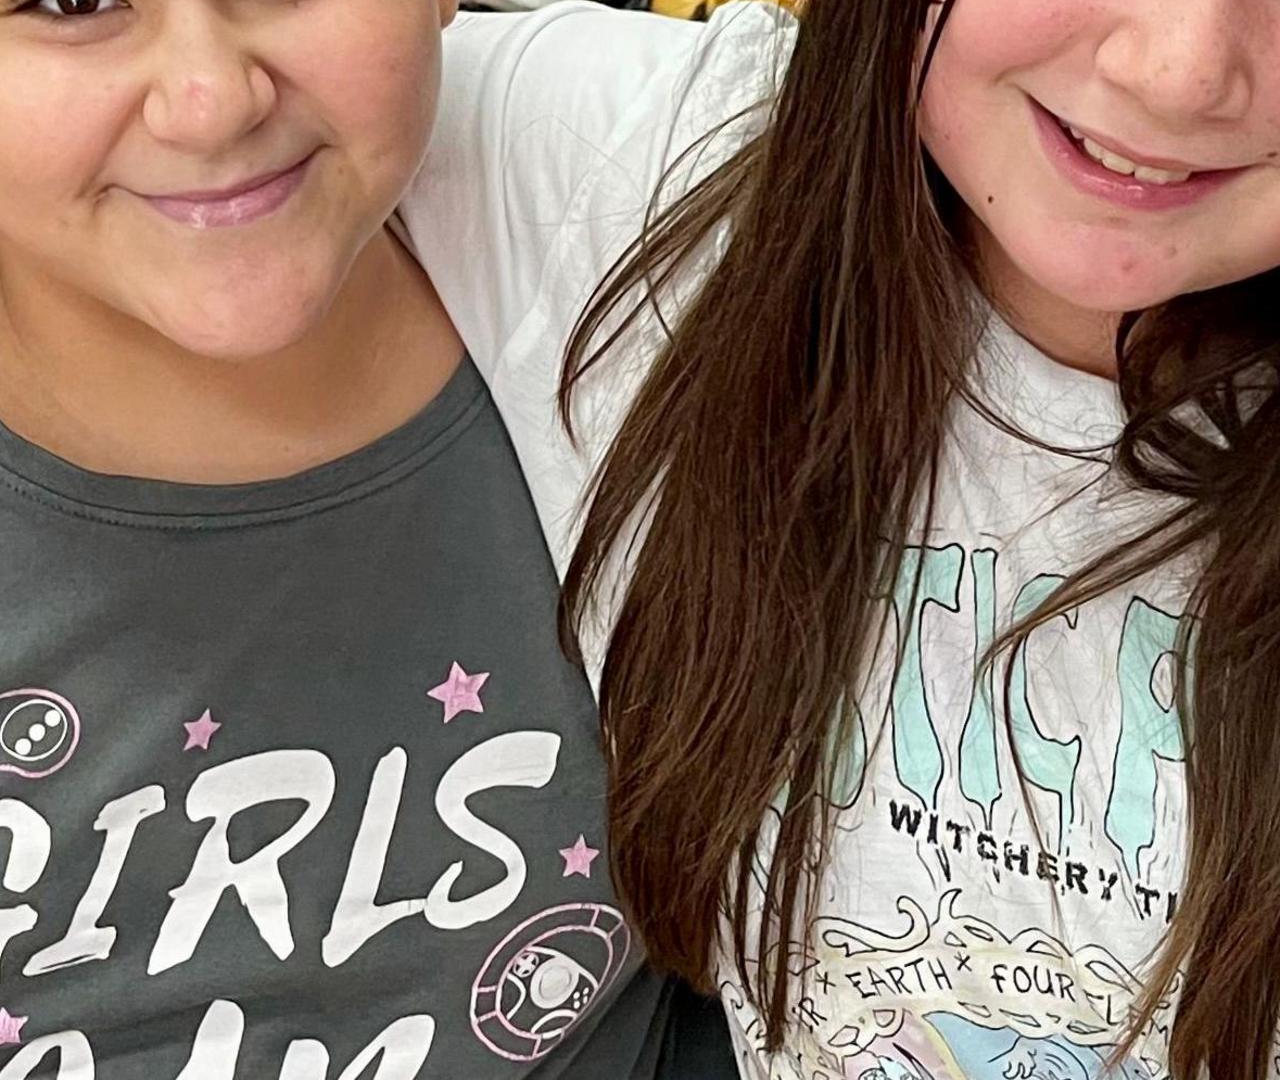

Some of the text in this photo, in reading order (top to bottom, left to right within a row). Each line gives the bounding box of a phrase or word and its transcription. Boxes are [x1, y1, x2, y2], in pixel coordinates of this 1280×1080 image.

[888, 799, 1119, 901] WITCHERY
[846, 956, 954, 1000] EARTH
[990, 965, 1077, 1003] FOUR
